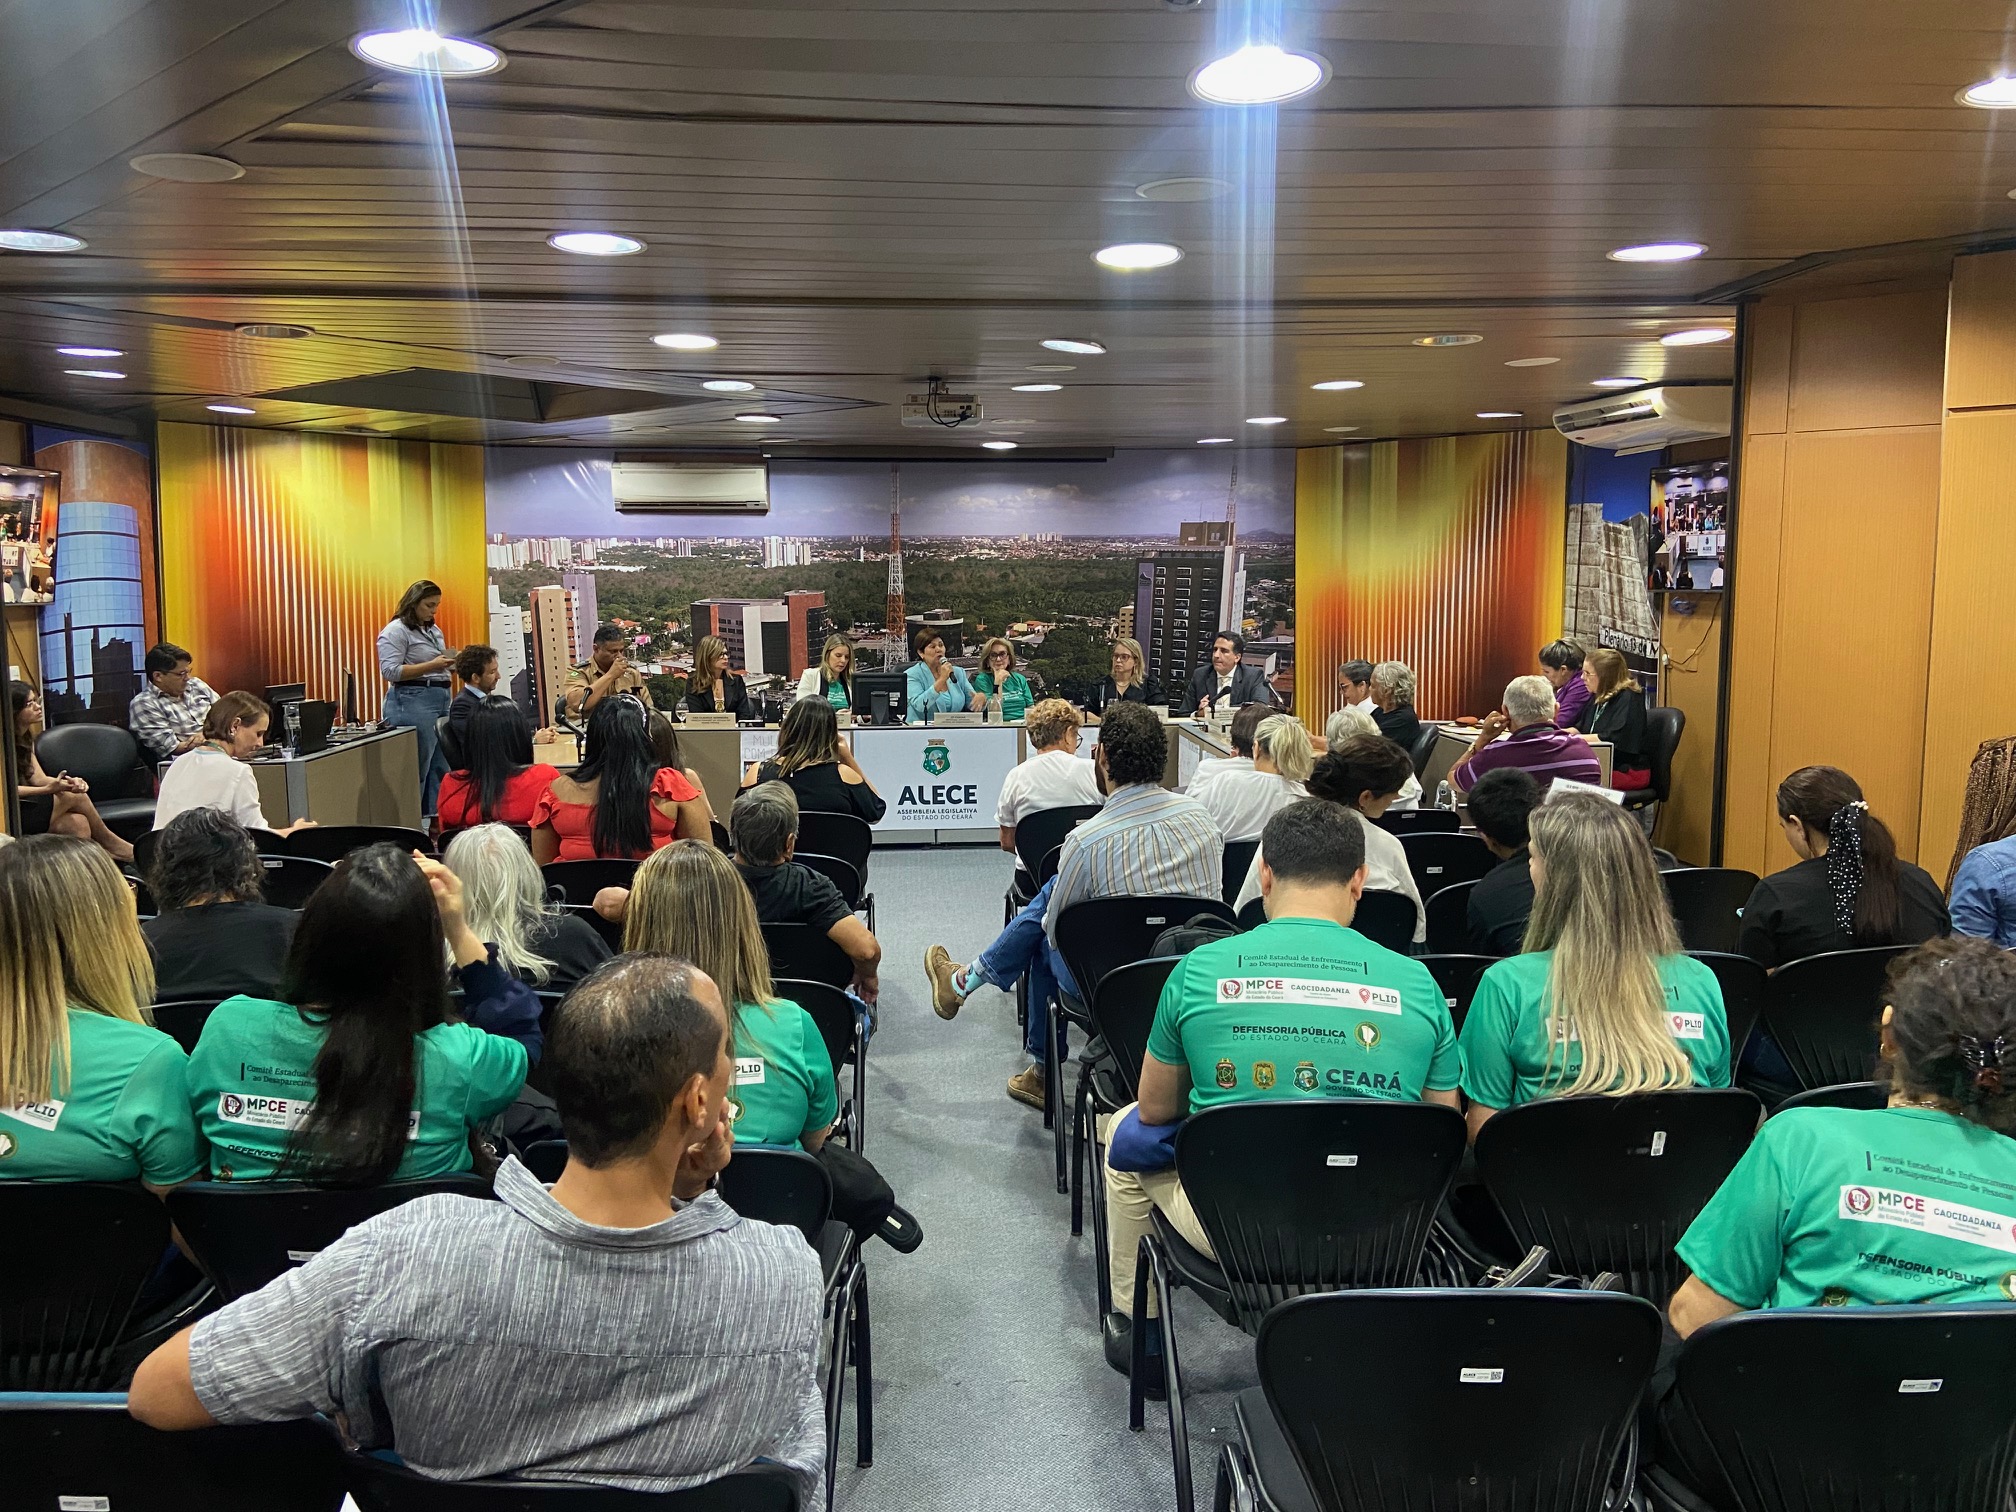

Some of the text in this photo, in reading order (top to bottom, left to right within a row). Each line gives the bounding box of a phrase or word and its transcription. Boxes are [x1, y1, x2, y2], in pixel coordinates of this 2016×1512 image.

[898, 785, 977, 805] ALECE
[1260, 961, 1318, 969] Desaparecimento
[1311, 956, 1362, 967] Enfrentamento
[1246, 980, 1284, 990] MPCE
[1291, 984, 1350, 994] CAOCIDADANIA
[1372, 993, 1398, 1004] PLID
[1685, 1020, 1701, 1028] PLID
[1233, 1026, 1346, 1038] DEFENSORIA PÚBLICA
[1314, 1037, 1347, 1045] CEARÁ
[247, 1065, 309, 1078] Comitê Estadual
[735, 1065, 760, 1073] PLID
[1326, 1069, 1401, 1091] CEARÁ
[1326, 1085, 1364, 1093] GOVERNO
[1376, 1090, 1401, 1098] ESTADO
[26, 1102, 57, 1118] PLID
[247, 1098, 287, 1113] MPCE
[1878, 1192, 1925, 1212] MPCE
[1934, 1208, 2002, 1231] CAOCIDADANIA
[1875, 1265, 1921, 1282] ESTADO
[1928, 1277, 1945, 1286] DO
